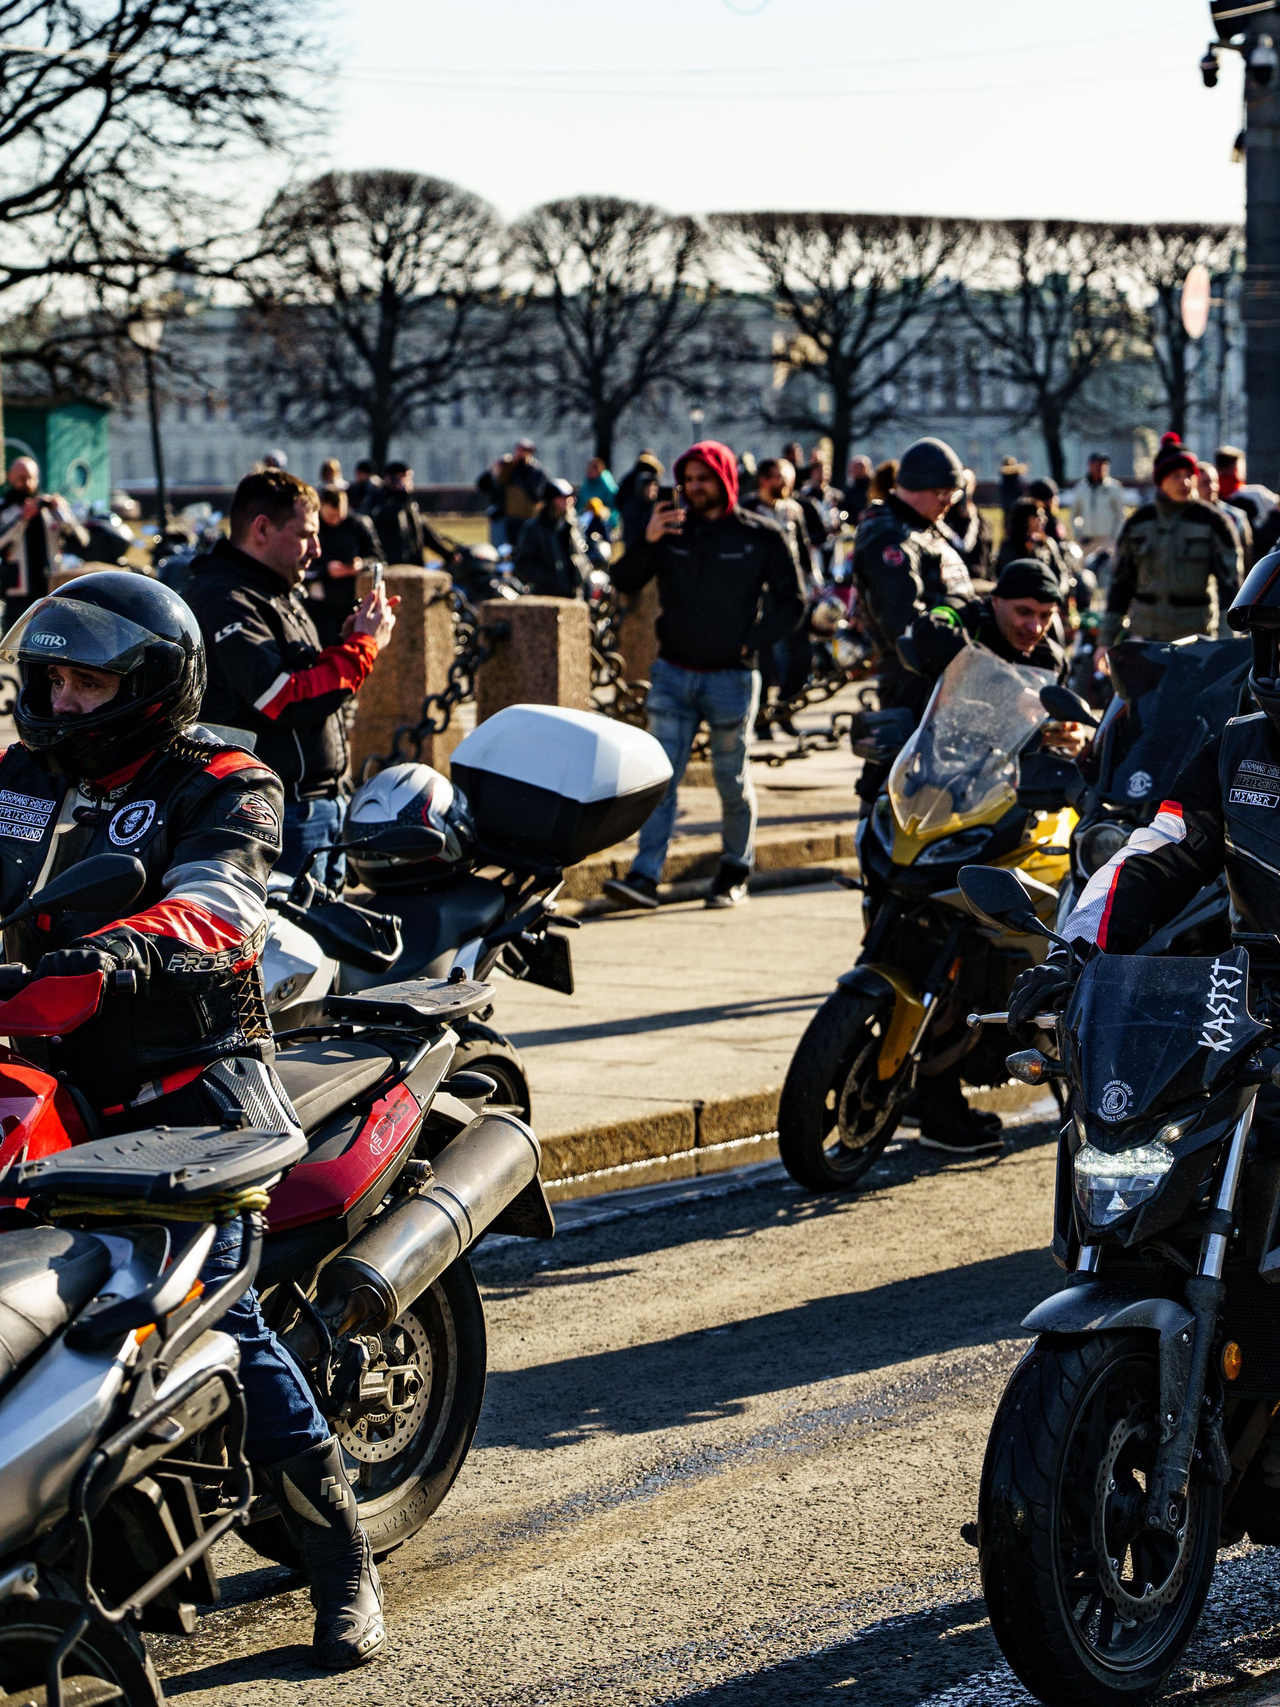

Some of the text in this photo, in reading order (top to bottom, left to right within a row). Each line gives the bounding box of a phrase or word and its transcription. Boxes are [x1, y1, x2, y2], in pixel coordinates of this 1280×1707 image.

[34, 634, 63, 647] MTR
[214, 621, 243, 643] LS2
[1233, 790, 1270, 806] MEMBER
[166, 918, 267, 973] PROSPEED
